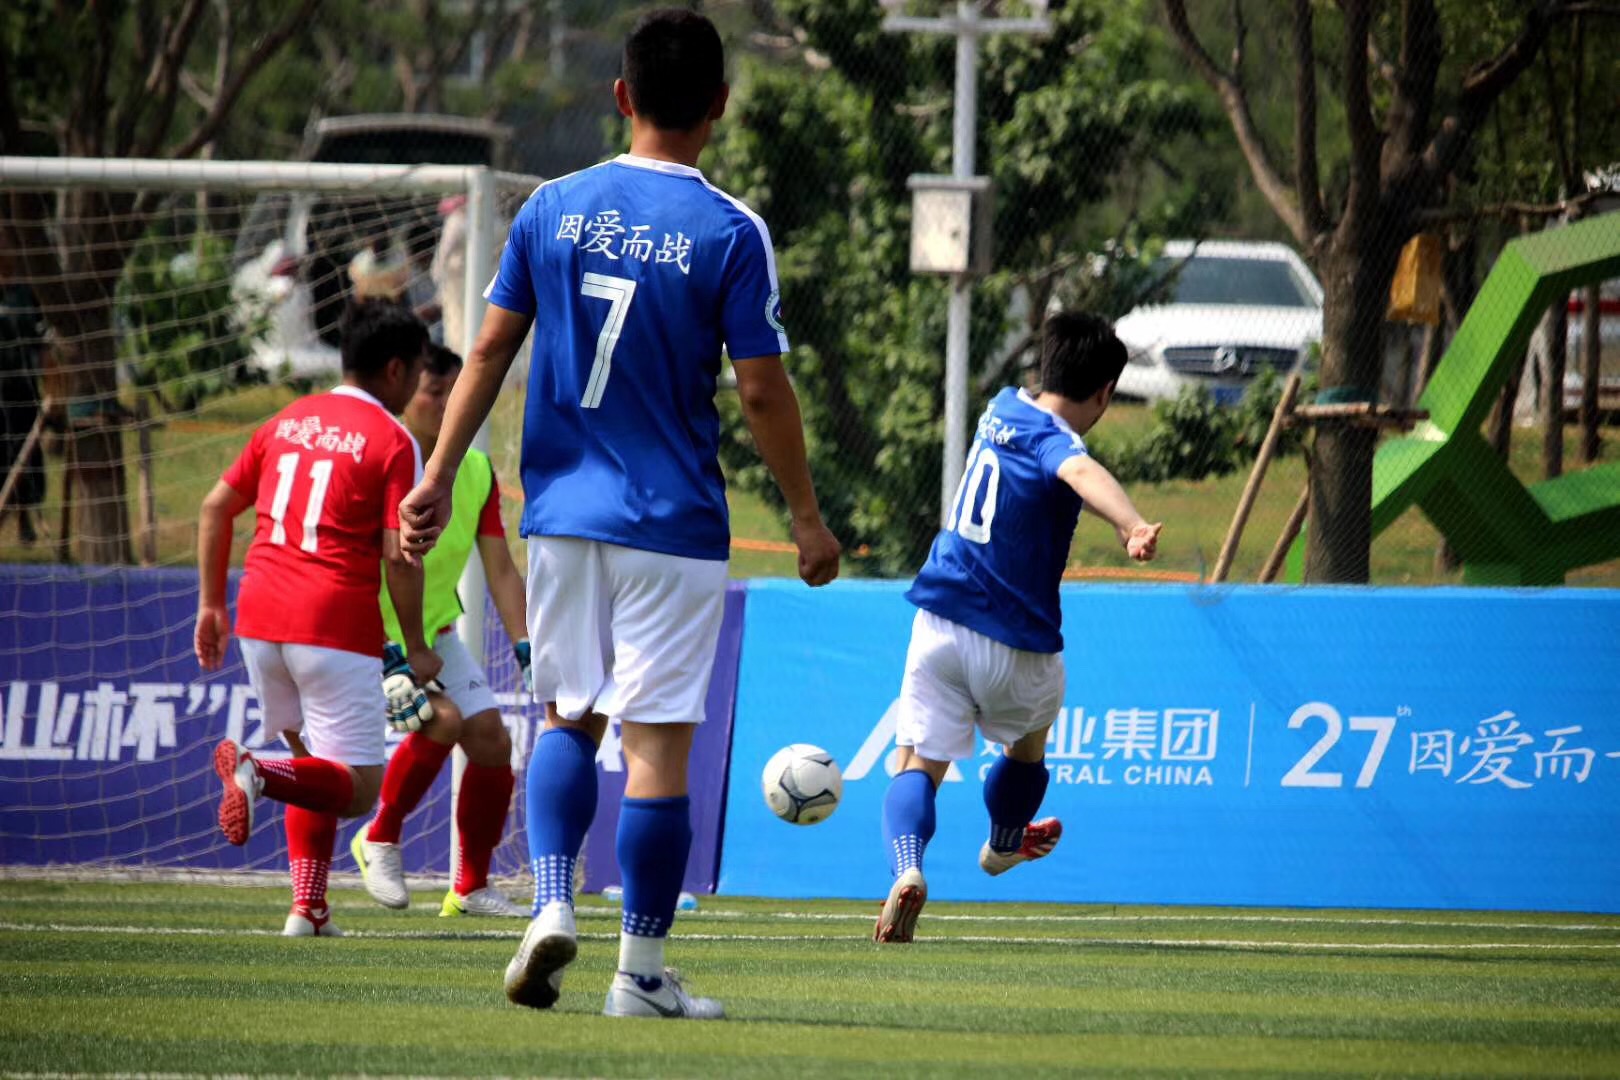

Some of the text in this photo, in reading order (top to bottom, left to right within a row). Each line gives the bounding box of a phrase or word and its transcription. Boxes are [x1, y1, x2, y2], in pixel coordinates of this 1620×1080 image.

[556, 209, 692, 275] 因爱而战
[580, 272, 637, 409] 7
[269, 452, 334, 553] 11
[946, 439, 1000, 545] 10
[980, 706, 1220, 761] 业集团
[1408, 710, 1620, 789] 因爱而
[1123, 764, 1214, 786] CHINA
